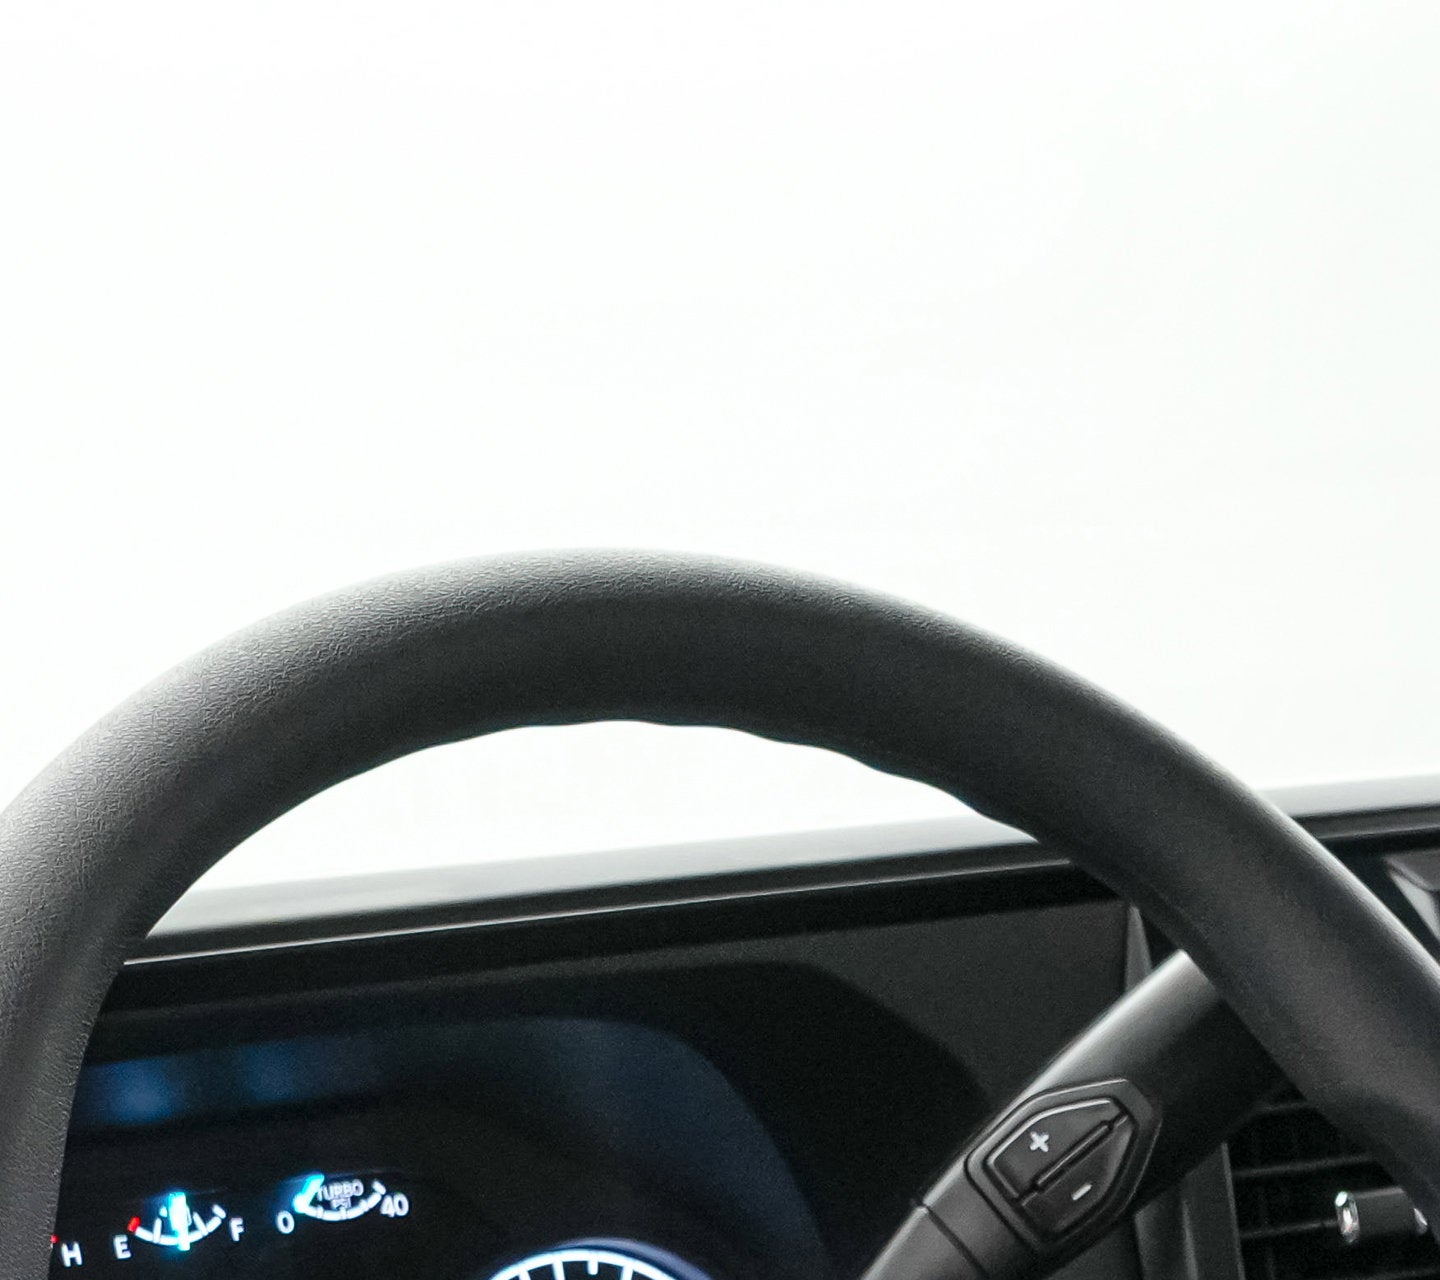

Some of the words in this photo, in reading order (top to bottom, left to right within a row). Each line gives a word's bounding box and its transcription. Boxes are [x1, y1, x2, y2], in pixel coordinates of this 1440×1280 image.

[380, 1192, 409, 1218] 40
[229, 1217, 245, 1242] F
[61, 1241, 83, 1268] H
[114, 1234, 131, 1260] E
